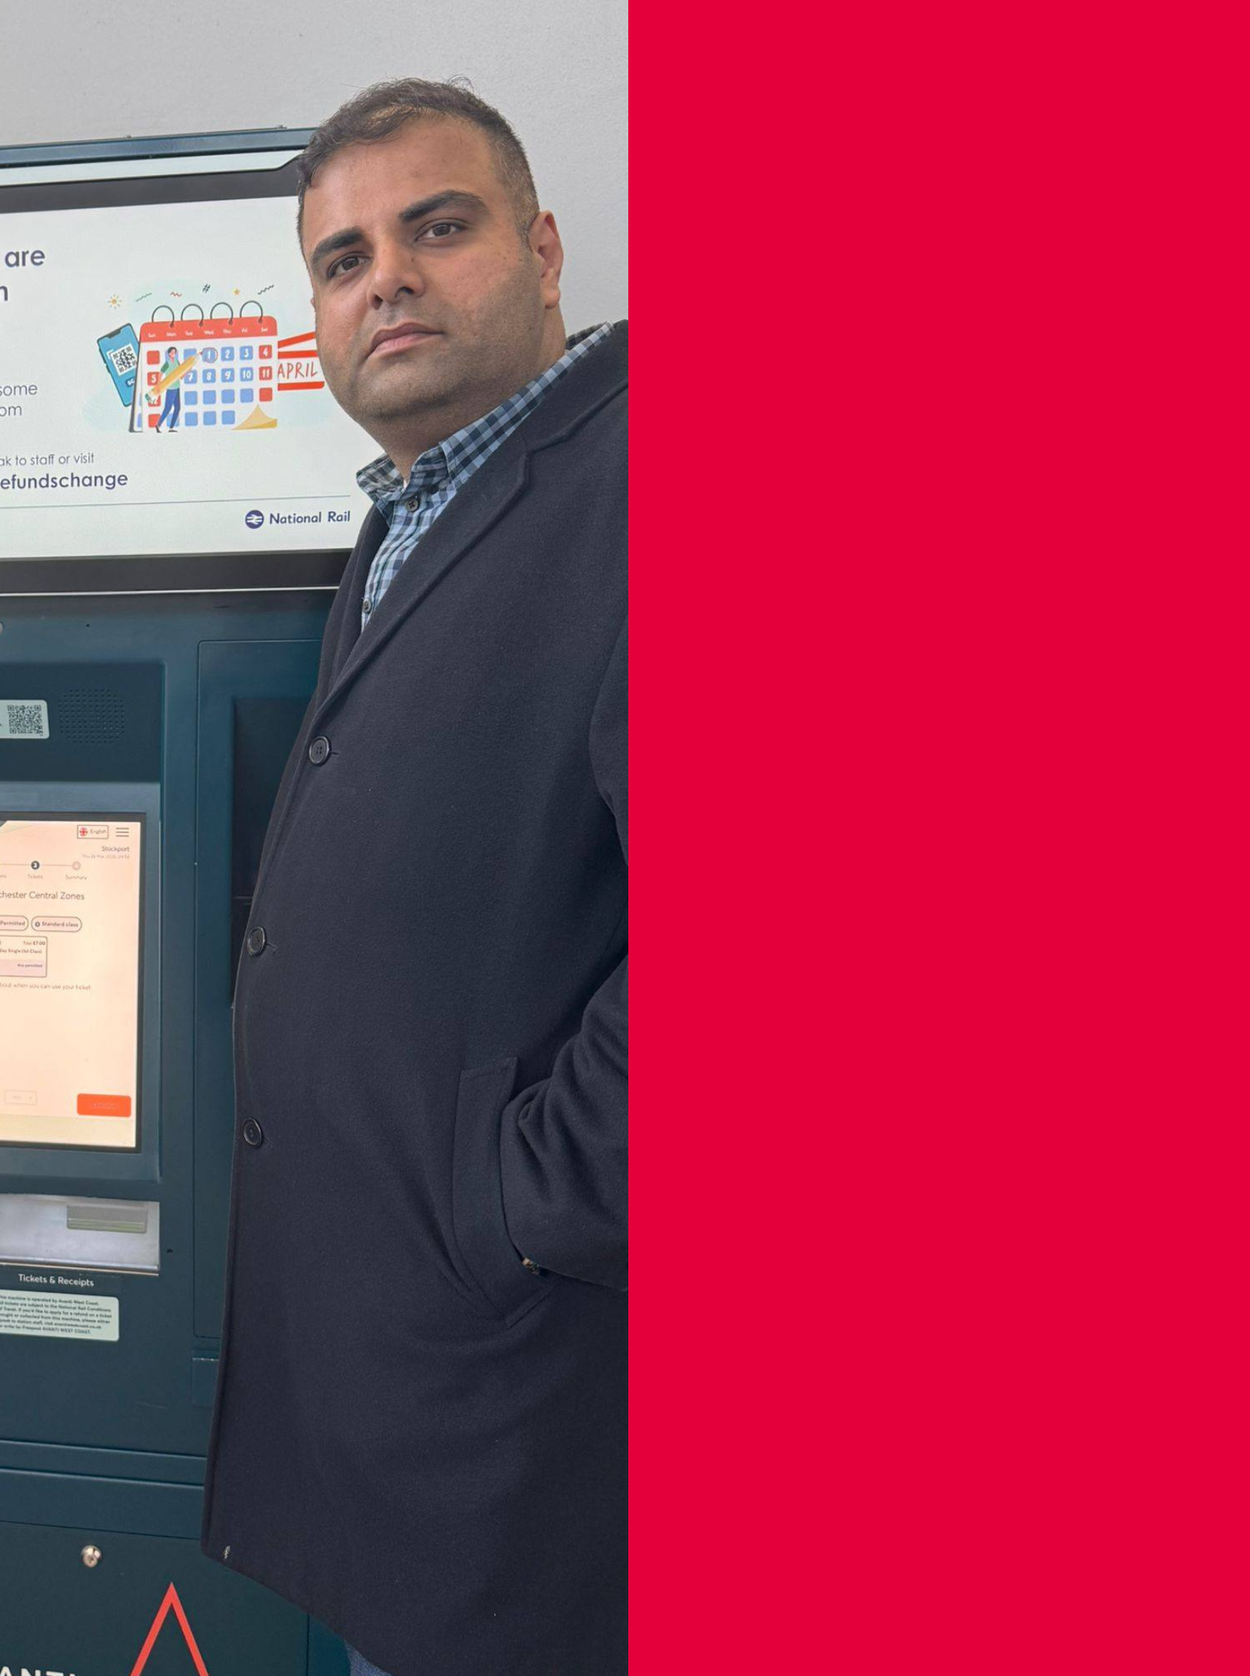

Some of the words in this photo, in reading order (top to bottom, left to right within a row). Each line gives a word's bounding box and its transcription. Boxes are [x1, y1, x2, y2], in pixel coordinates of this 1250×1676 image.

[4, 249, 45, 268] are
[224, 349, 230, 359] 2
[244, 348, 249, 358] 3
[262, 348, 268, 357] 4
[151, 374, 157, 384] 5
[188, 372, 193, 381] 7
[206, 371, 212, 380] 8
[224, 370, 231, 380] 9
[242, 369, 252, 379] 10
[262, 368, 270, 377] 11
[277, 361, 318, 379] APRIL
[15, 456, 27, 466] to
[30, 453, 55, 466] staff
[58, 455, 70, 465] or
[73, 452, 95, 464] visit
[269, 511, 322, 525] National
[327, 510, 351, 523] Rail
[29, 891, 58, 900] Central
[60, 891, 85, 900] Zones
[18, 1273, 48, 1284] Tickets
[49, 1275, 56, 1284] &
[57, 1276, 95, 1287] Receipts
